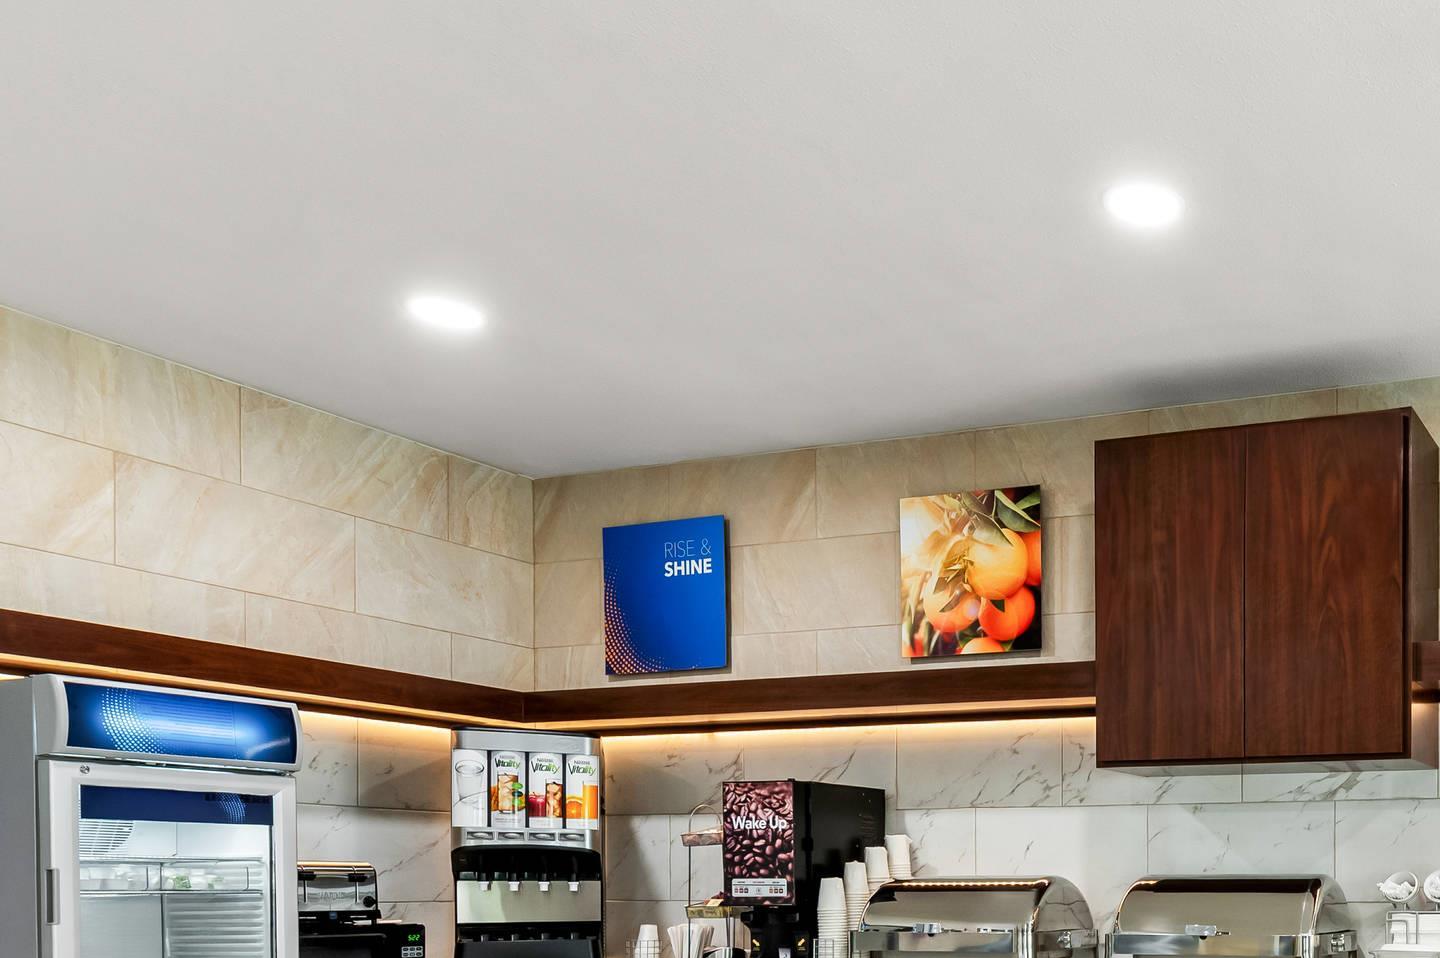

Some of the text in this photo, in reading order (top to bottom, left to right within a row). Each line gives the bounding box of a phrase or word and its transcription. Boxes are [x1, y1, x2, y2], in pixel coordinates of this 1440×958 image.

[664, 537, 712, 559] RISE &
[664, 557, 713, 577] SHINE
[494, 757, 520, 770] Vitality
[530, 760, 560, 774] Vitality
[567, 762, 597, 777] Vitality
[731, 815, 788, 832] Wake Up
